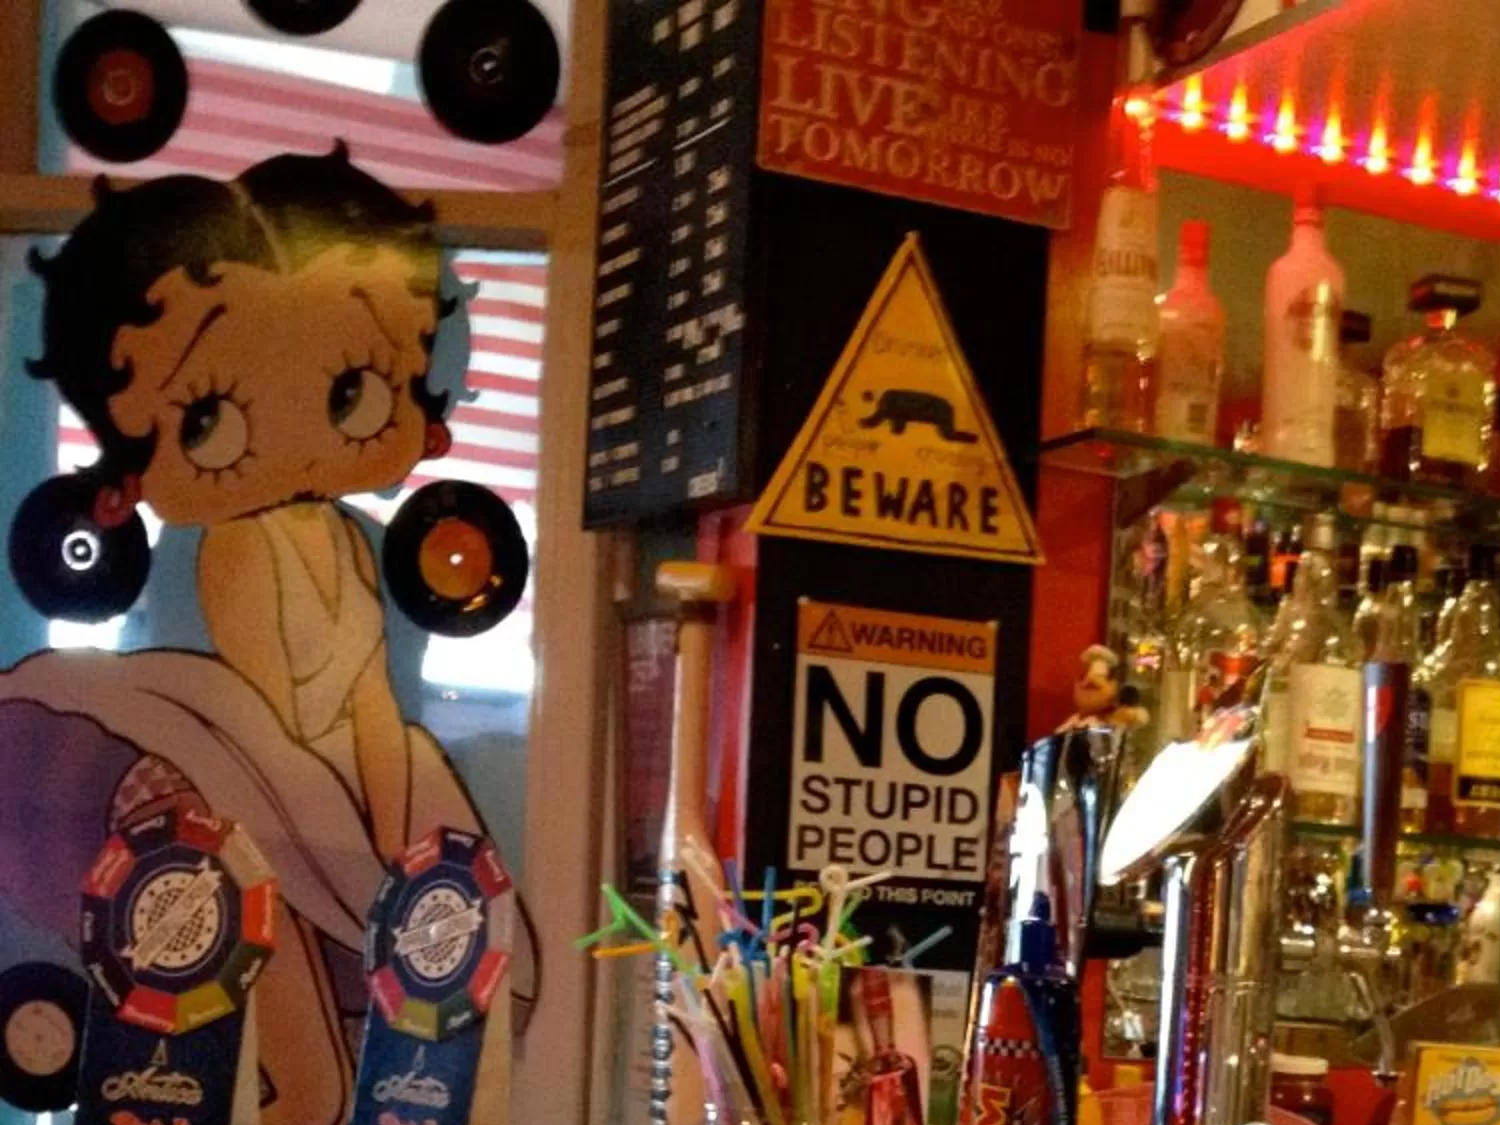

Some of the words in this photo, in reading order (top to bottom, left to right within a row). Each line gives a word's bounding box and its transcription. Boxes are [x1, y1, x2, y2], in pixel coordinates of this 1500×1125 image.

[769, 53, 926, 135] LIVE
[773, 7, 1071, 108] LISTENING
[768, 113, 1067, 204] TOMORROW
[804, 460, 999, 534] BEWARE
[851, 620, 988, 660] WARNING
[803, 664, 984, 777] NO
[800, 773, 980, 826] STUPID
[795, 825, 983, 873] PEOPLE
[876, 884, 918, 905] THIS
[920, 886, 977, 908] POINT
